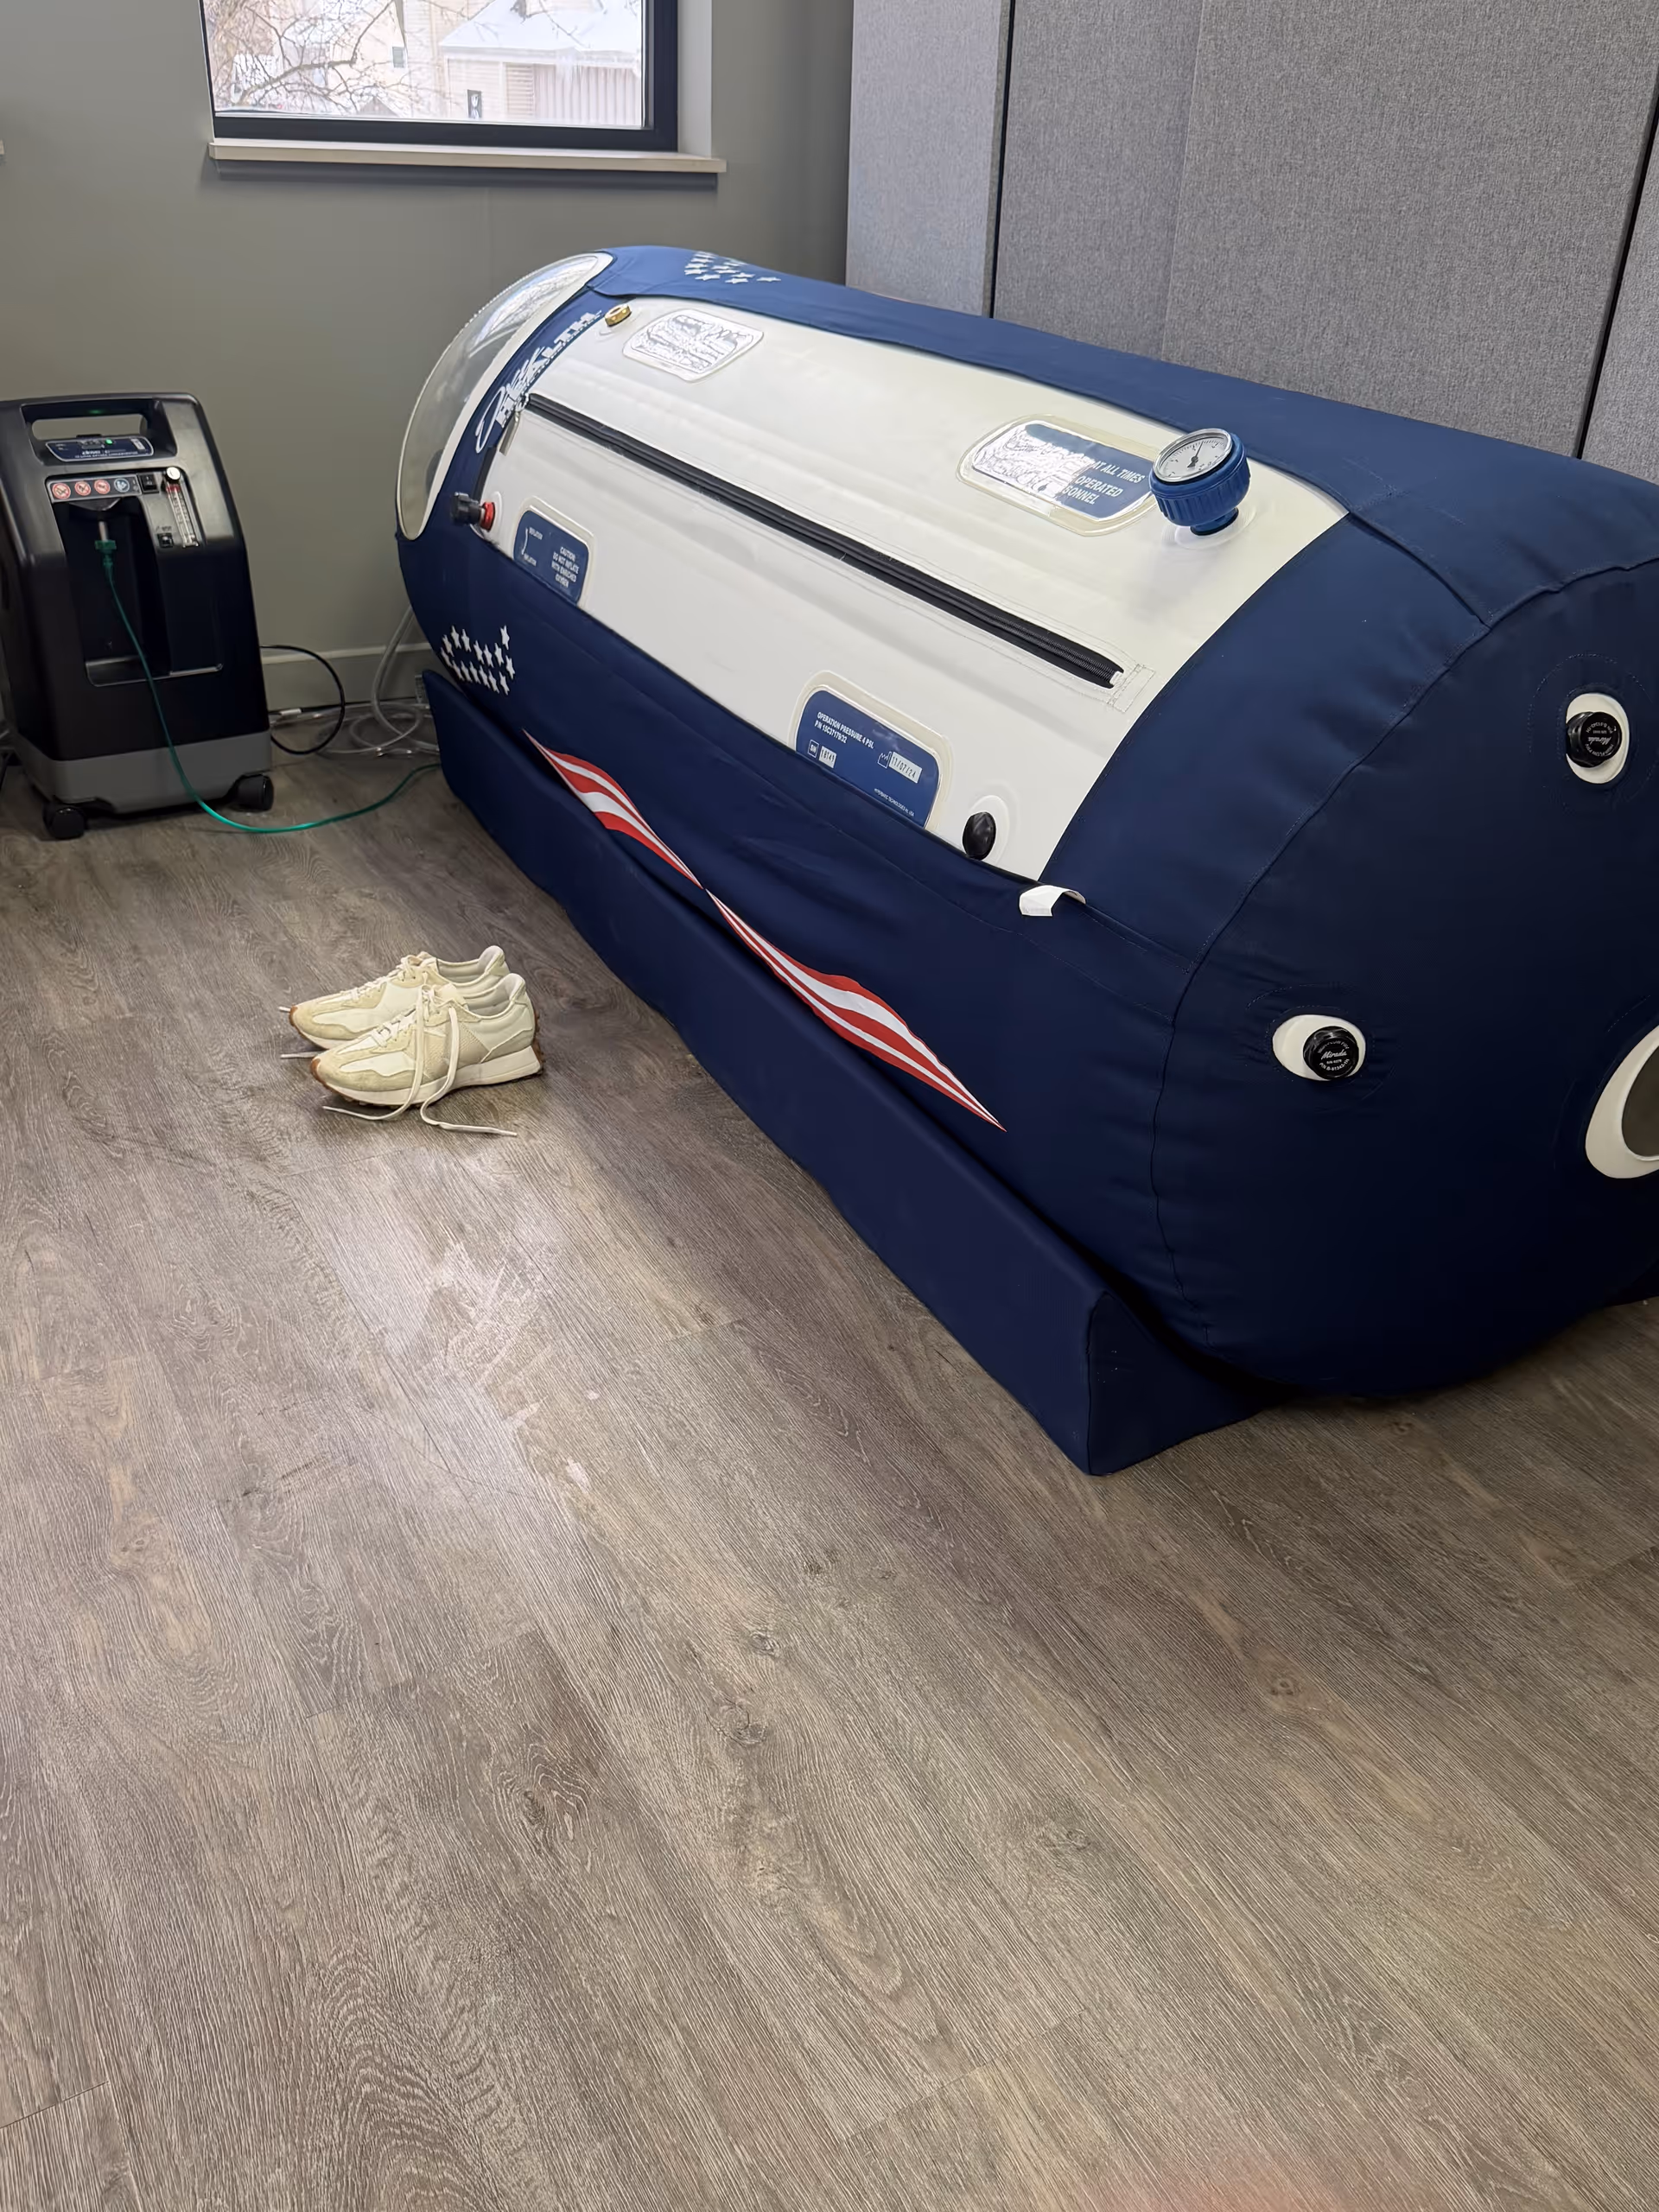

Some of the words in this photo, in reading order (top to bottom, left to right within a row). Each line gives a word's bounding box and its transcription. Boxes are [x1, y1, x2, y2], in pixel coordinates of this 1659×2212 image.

[1100, 464, 1120, 476] ALL
[1116, 468, 1145, 484] TIMES
[1062, 485, 1100, 505] SONNEL
[1074, 475, 1124, 498] OPERATED
[564, 558, 580, 575] INFLATE
[555, 573, 569, 588] OXYGEN
[817, 711, 841, 730] OPERATION
[839, 723, 863, 742] PRESSURE
[1320, 1048, 1348, 1060] Mirada
